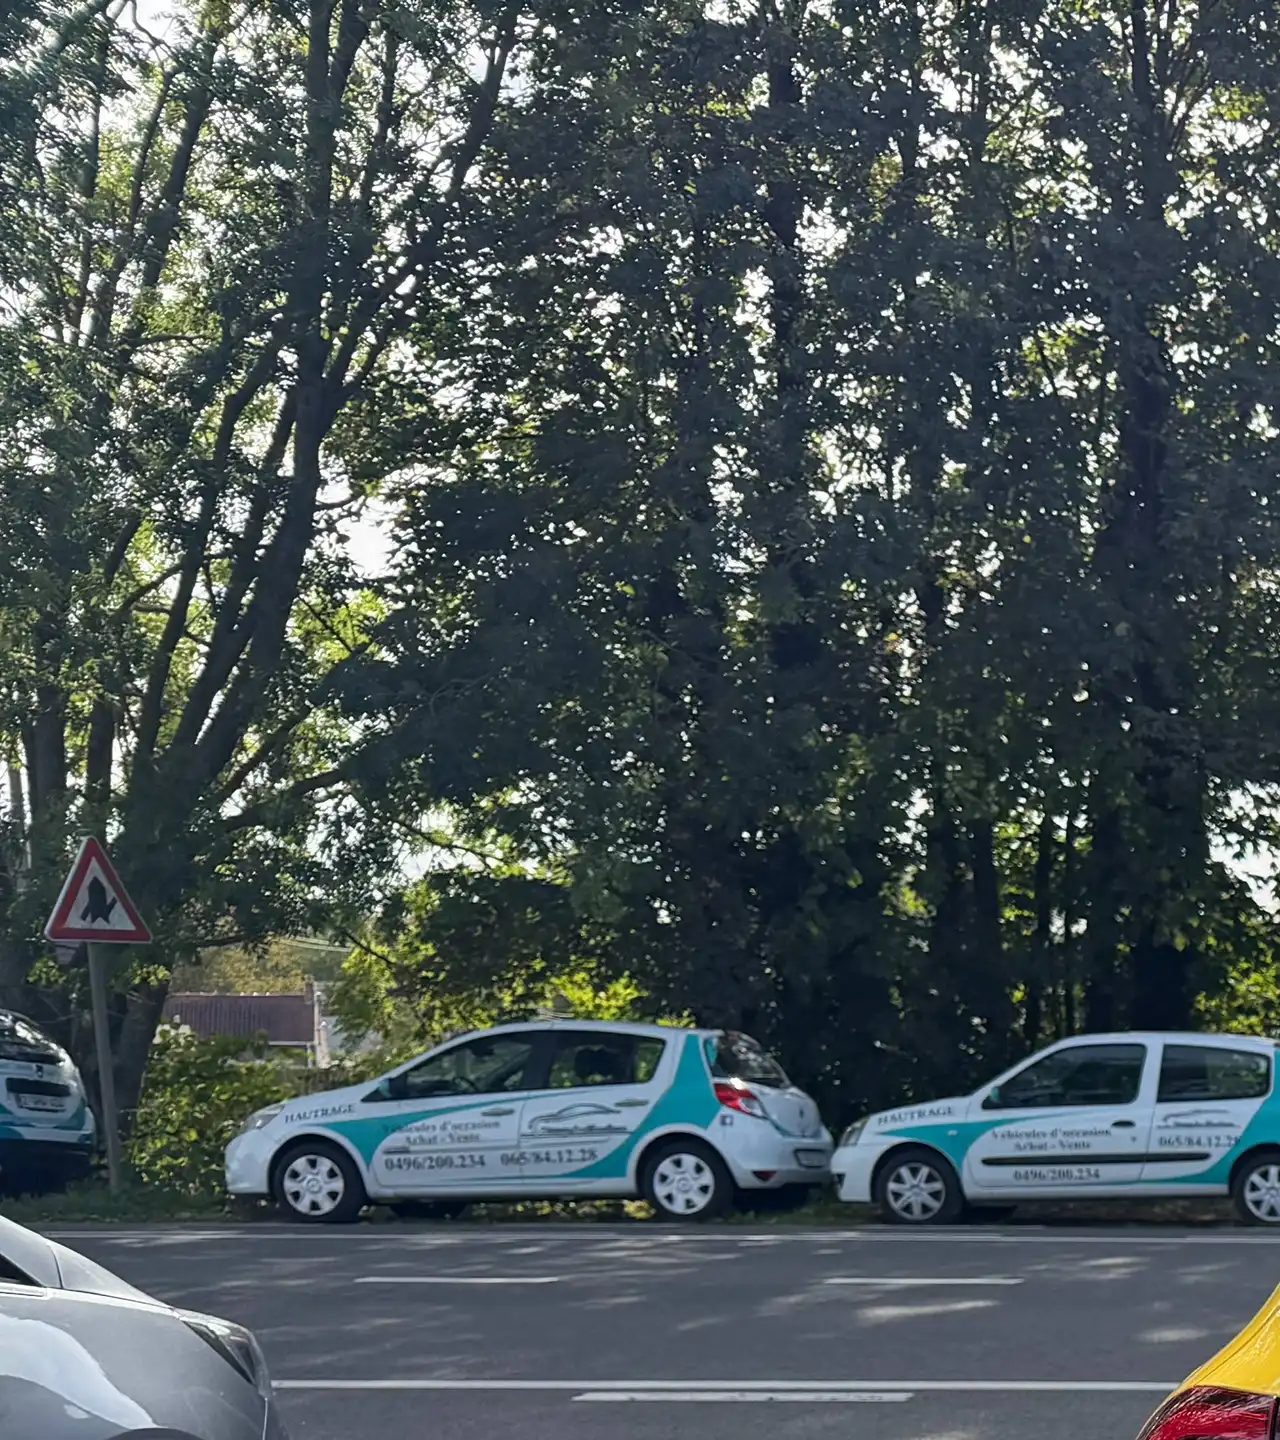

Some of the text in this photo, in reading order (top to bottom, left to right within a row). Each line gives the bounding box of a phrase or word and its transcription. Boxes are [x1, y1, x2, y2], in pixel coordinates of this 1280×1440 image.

[284, 1104, 356, 1124] HAUTRAGE
[878, 1105, 955, 1125] HAUTRAGE
[384, 1153, 487, 1171] 0496/200.234
